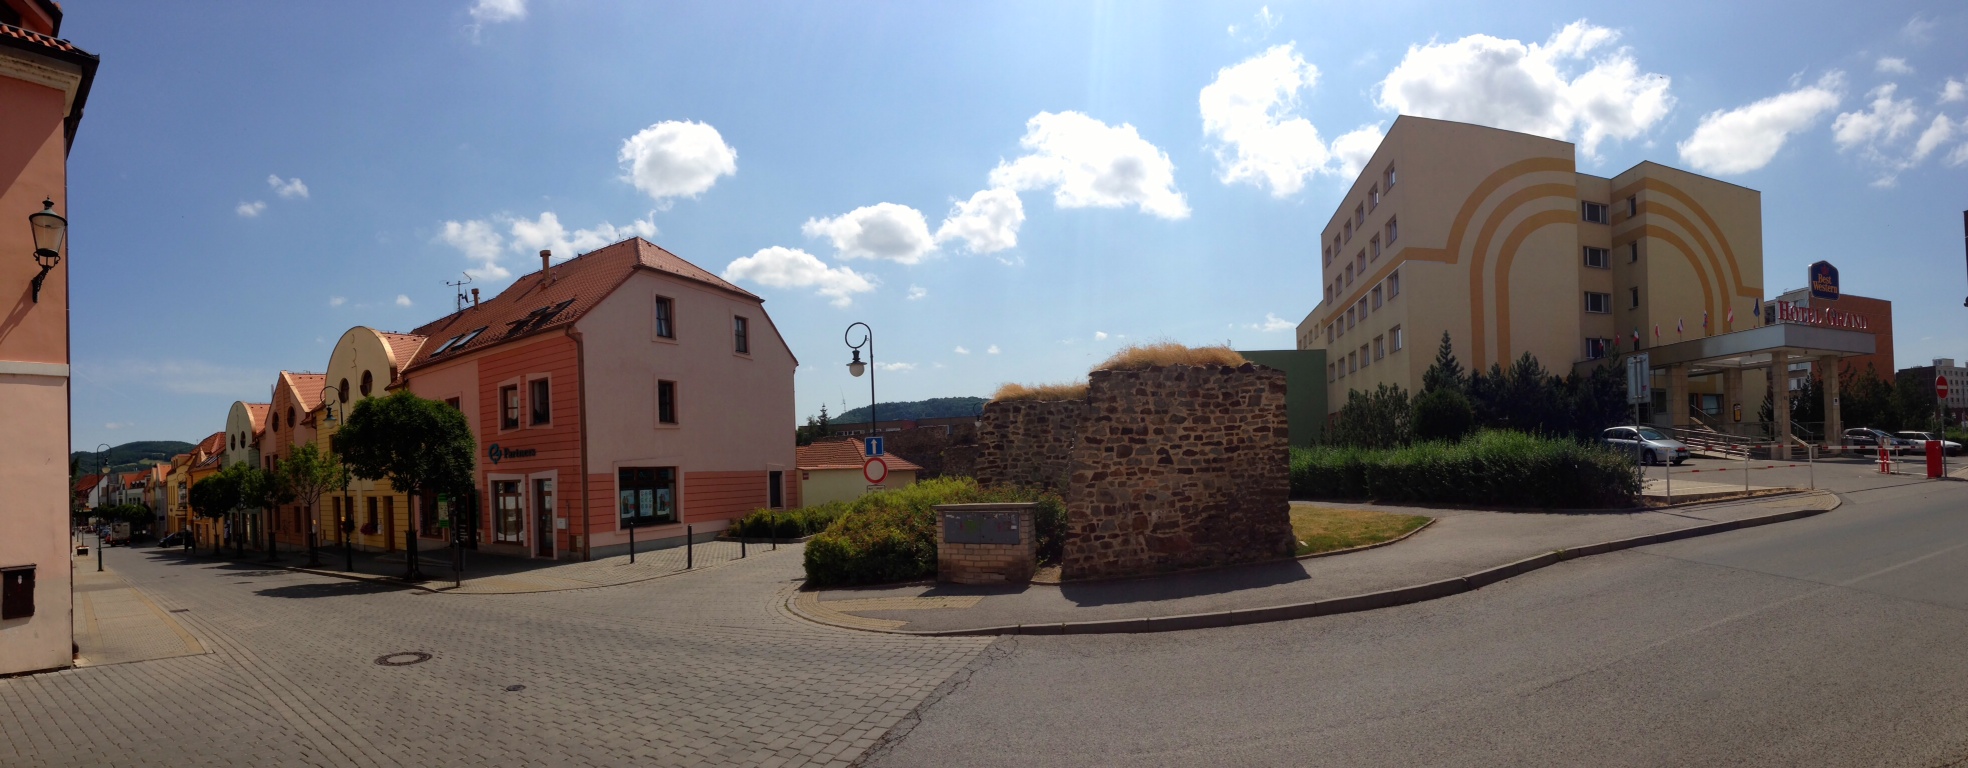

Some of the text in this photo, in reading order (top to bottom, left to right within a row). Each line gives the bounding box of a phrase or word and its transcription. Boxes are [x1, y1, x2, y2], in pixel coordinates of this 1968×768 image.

[1818, 274, 1832, 284] Best
[1812, 280, 1838, 294] Western
[1778, 300, 1868, 328] HOTEL GRAND
[504, 447, 536, 458] Partners
